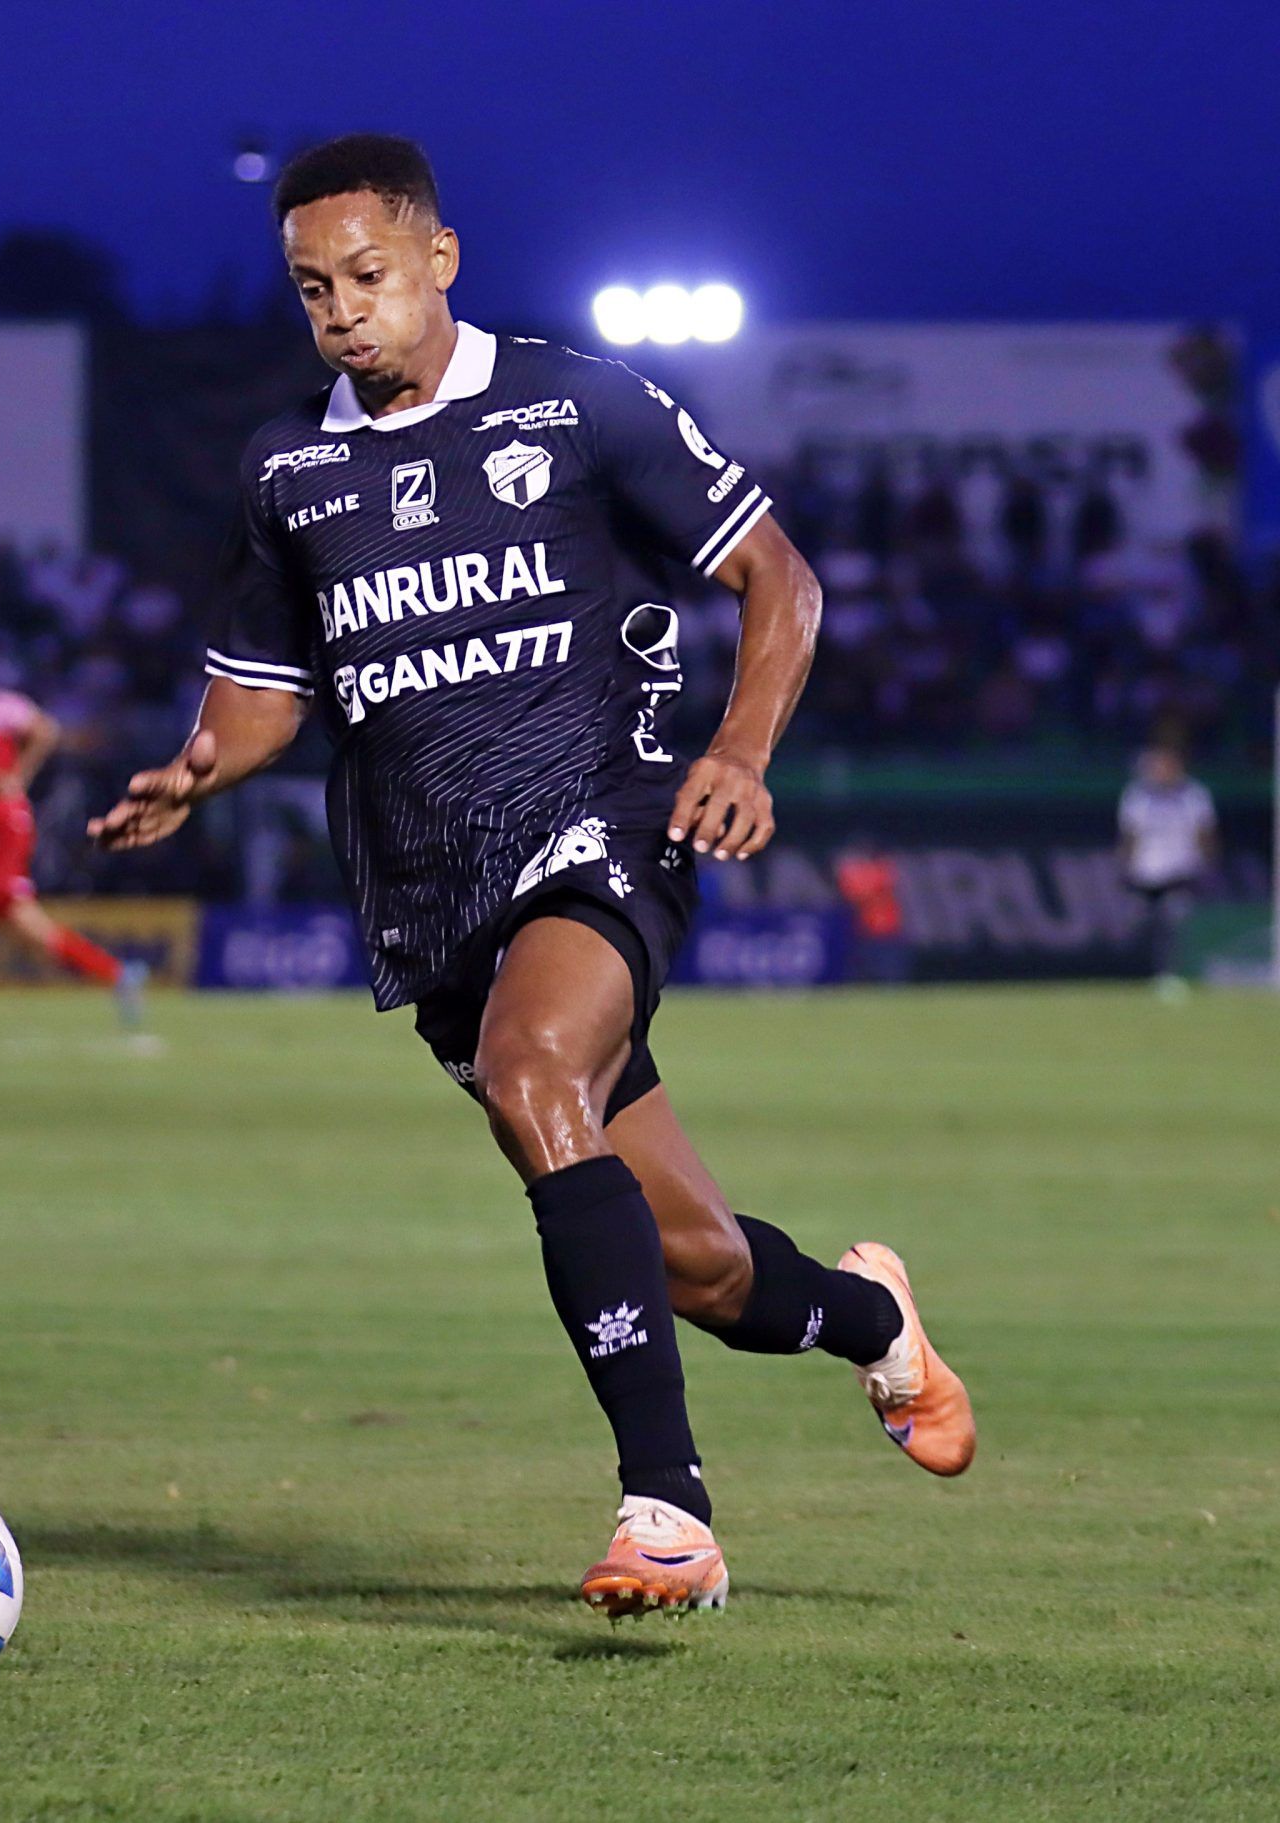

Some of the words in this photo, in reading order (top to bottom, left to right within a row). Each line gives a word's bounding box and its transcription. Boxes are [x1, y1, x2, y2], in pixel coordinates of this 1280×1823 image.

[397, 466, 429, 509] Z
[707, 459, 745, 503] GATOR
[287, 493, 360, 532] KELME
[399, 513, 428, 527] GAS
[317, 542, 566, 643] BANRURAL
[358, 620, 573, 704] GANA777
[589, 1328, 648, 1359] KELME
